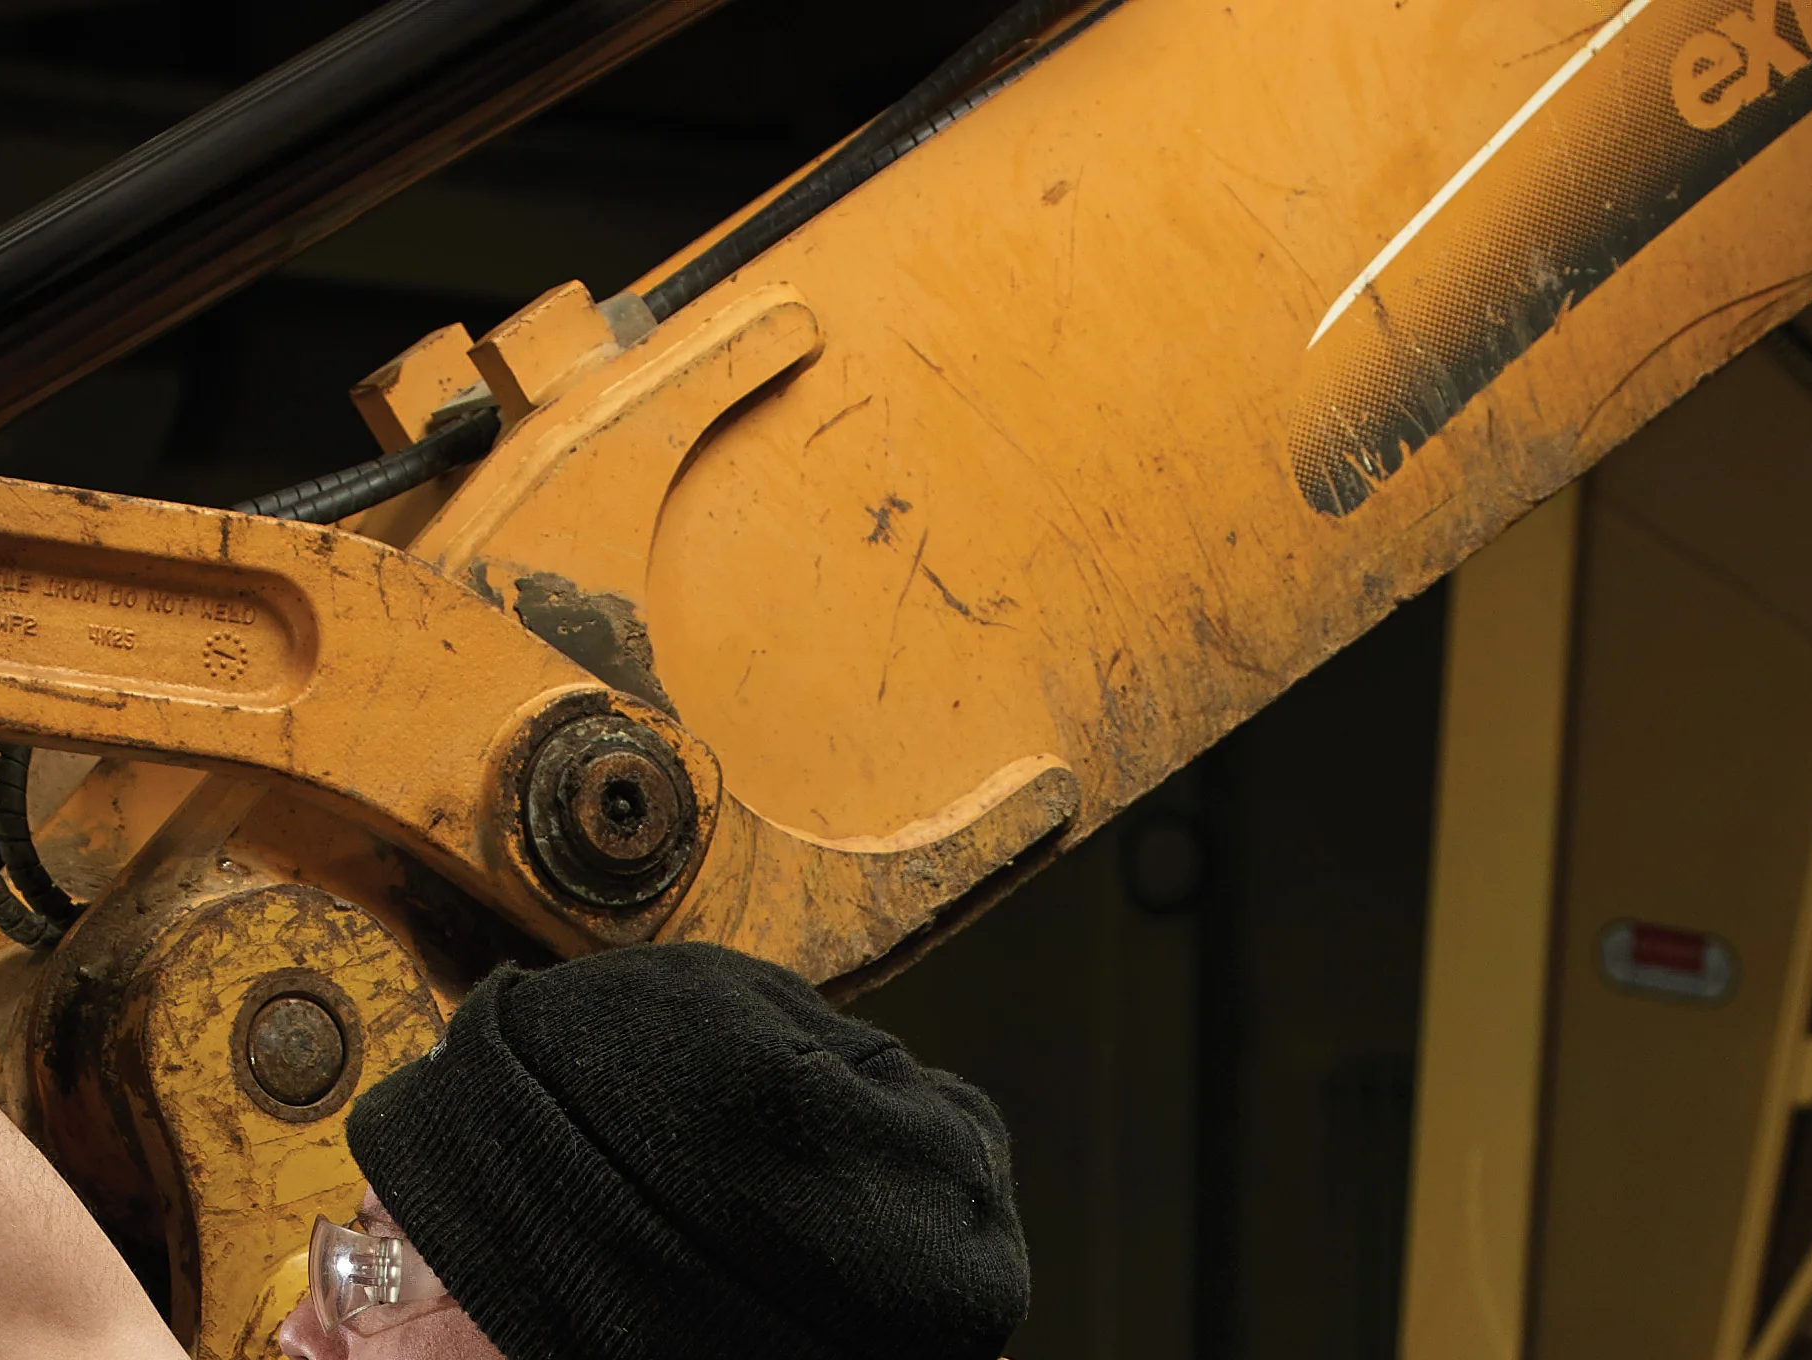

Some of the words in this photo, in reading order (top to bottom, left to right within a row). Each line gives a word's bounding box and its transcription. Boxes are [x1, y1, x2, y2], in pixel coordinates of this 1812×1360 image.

[43, 577, 99, 604] IRON
[109, 586, 137, 609] DO
[146, 592, 190, 617] NOT
[200, 600, 256, 626] WELD
